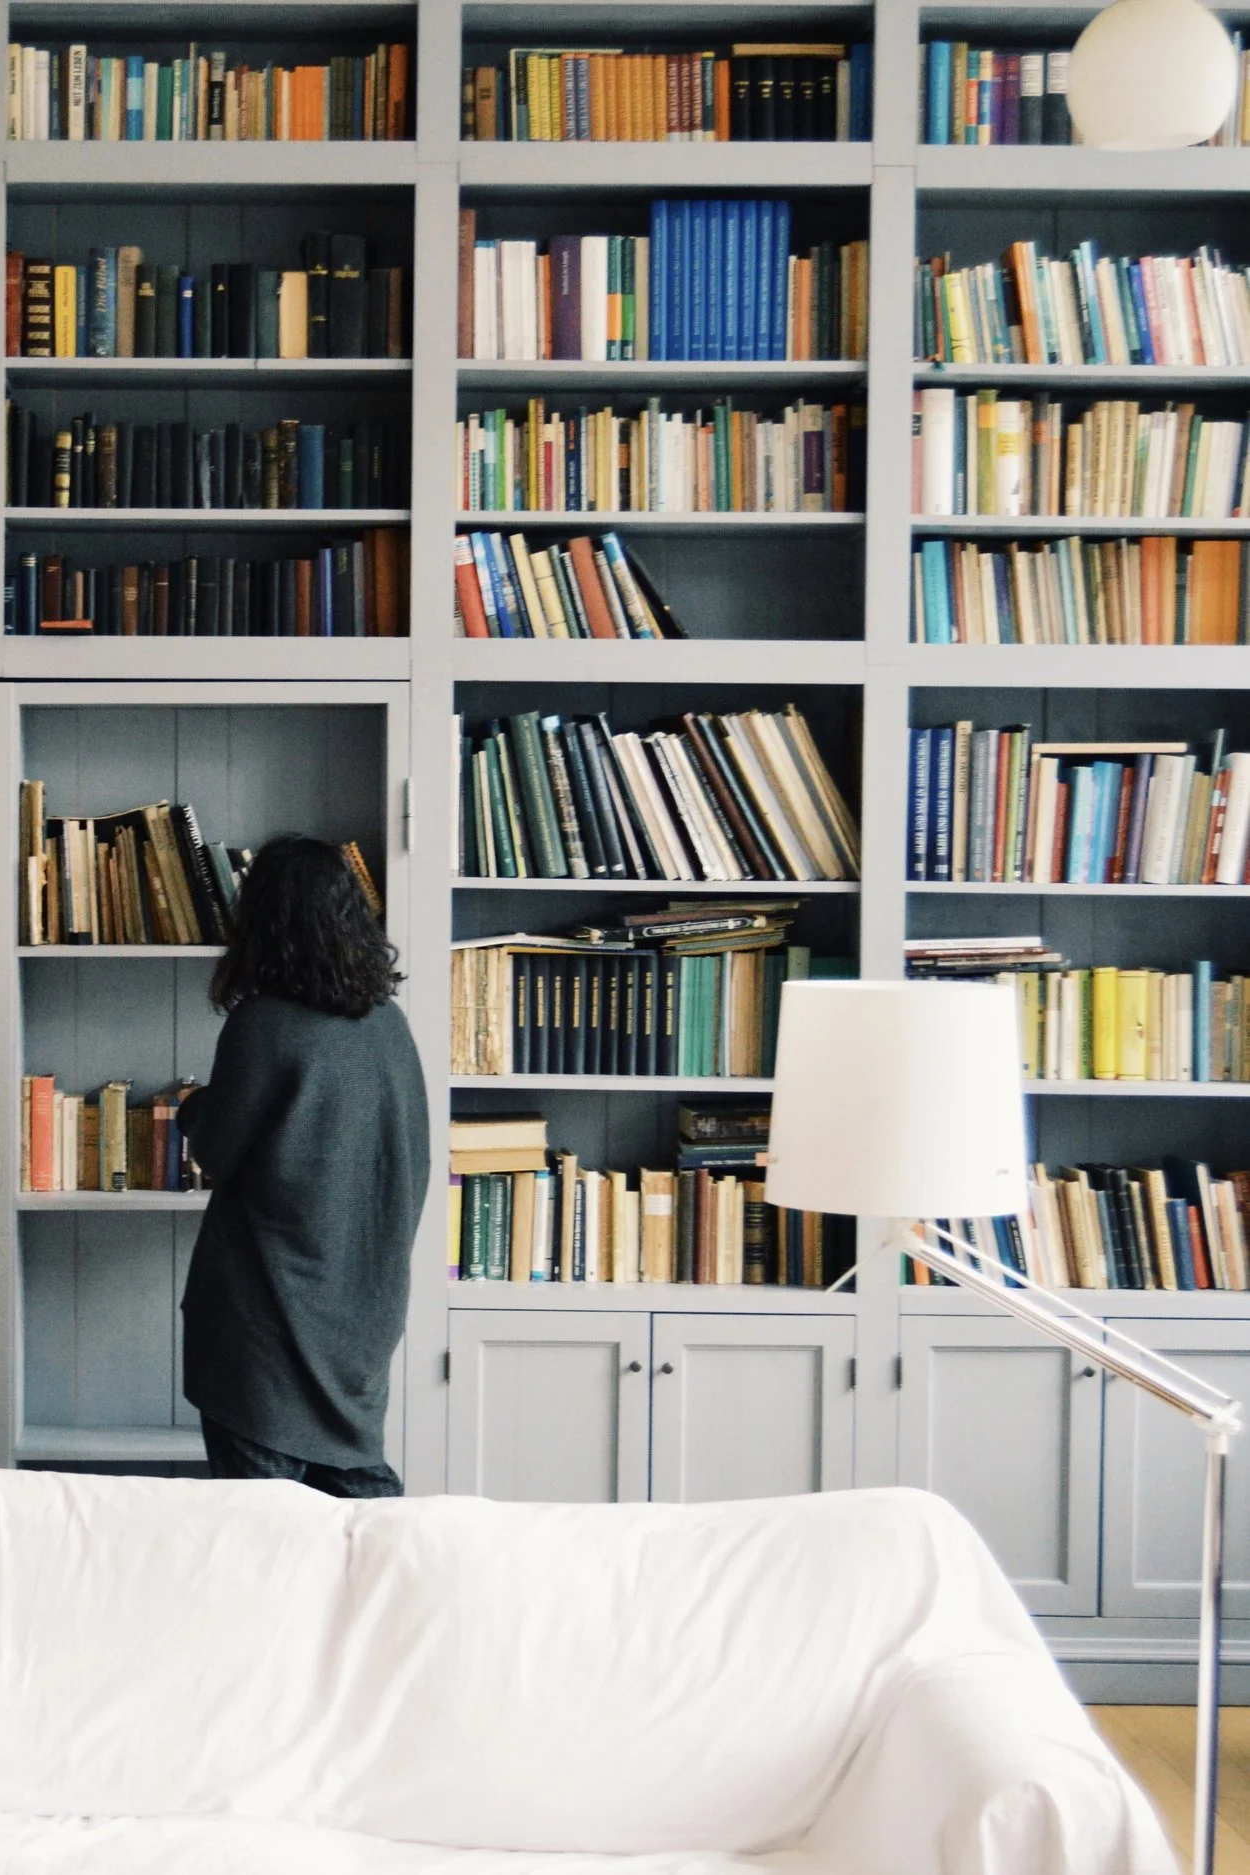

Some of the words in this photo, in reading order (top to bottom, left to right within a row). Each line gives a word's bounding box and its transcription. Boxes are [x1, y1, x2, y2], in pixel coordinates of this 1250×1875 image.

[72, 50, 81, 74] LEBEN
[72, 75, 82, 90] ZUM
[73, 91, 82, 107] MUT
[95, 257, 106, 289] Bibel
[95, 291, 107, 313] Die
[958, 727, 968, 757] PETER
[915, 798, 926, 814] SALZ
[914, 815, 926, 830] UND
[937, 816, 948, 832] UND
[914, 831, 925, 855] SILBER
